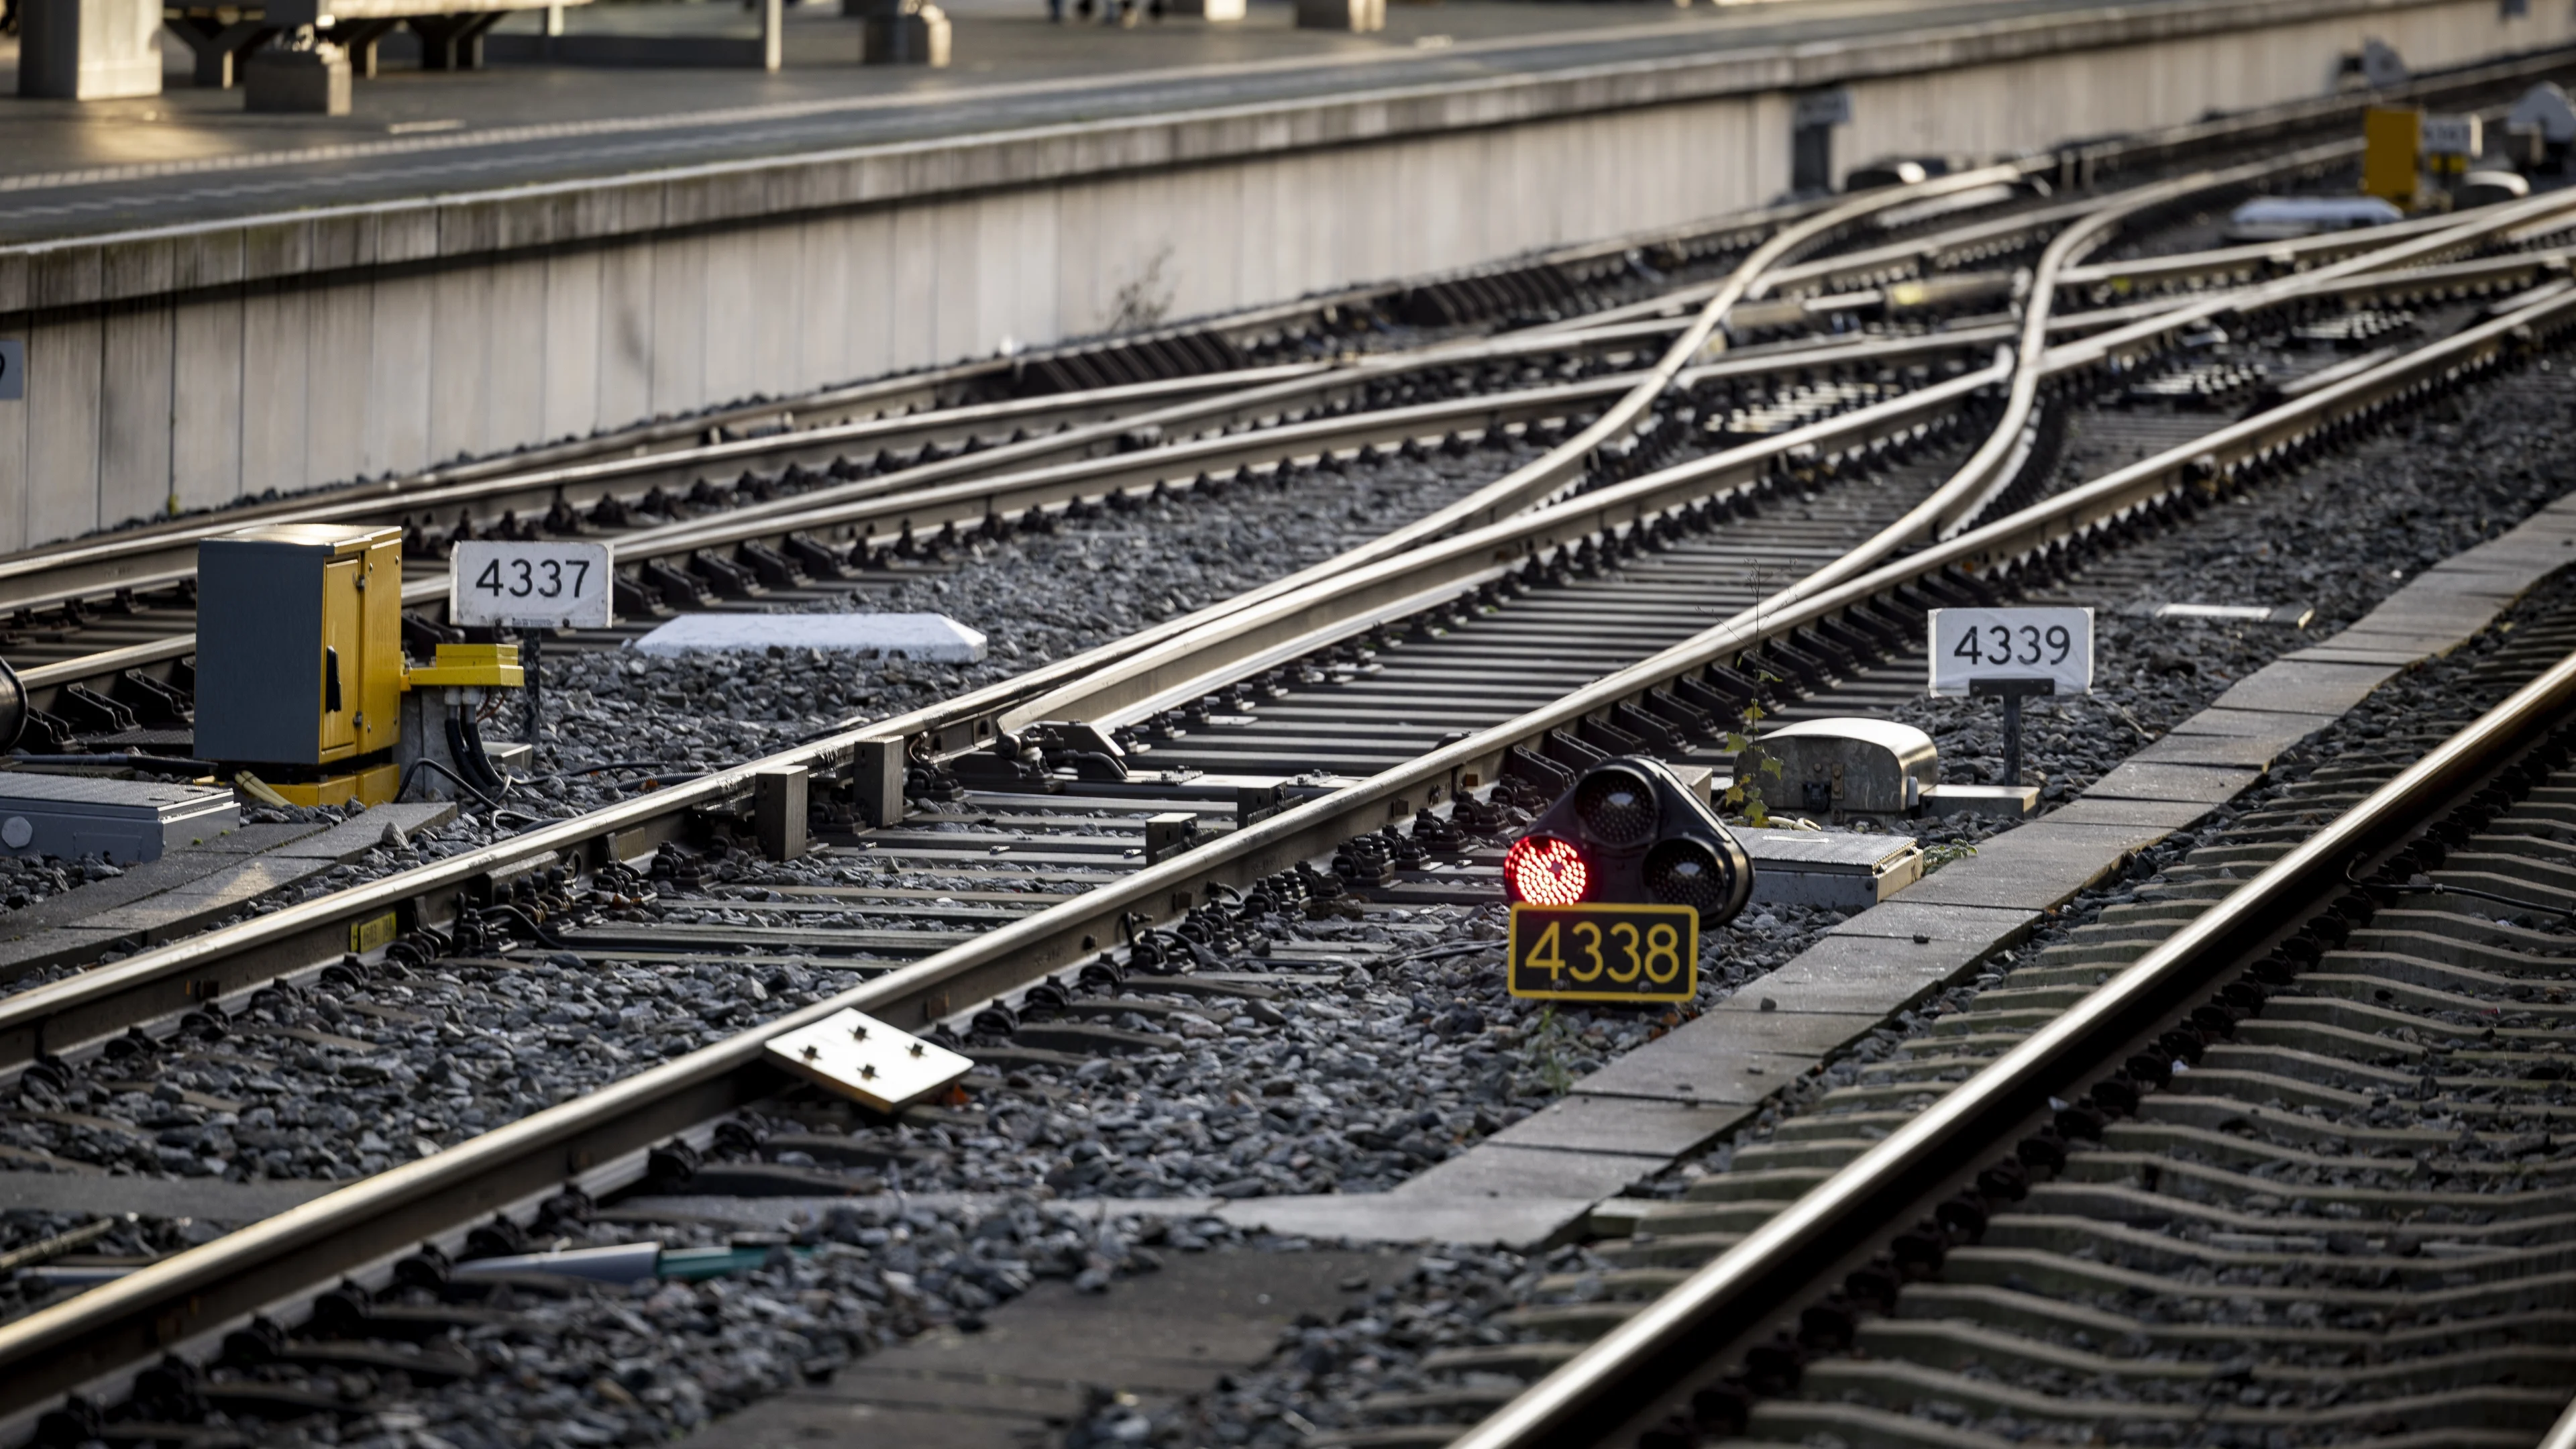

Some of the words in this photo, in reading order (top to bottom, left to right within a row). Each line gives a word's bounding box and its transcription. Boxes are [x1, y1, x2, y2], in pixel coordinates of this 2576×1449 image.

[476, 558, 590, 598] 4337
[1953, 625, 2070, 665] 4339
[1525, 920, 1680, 984] 4338
